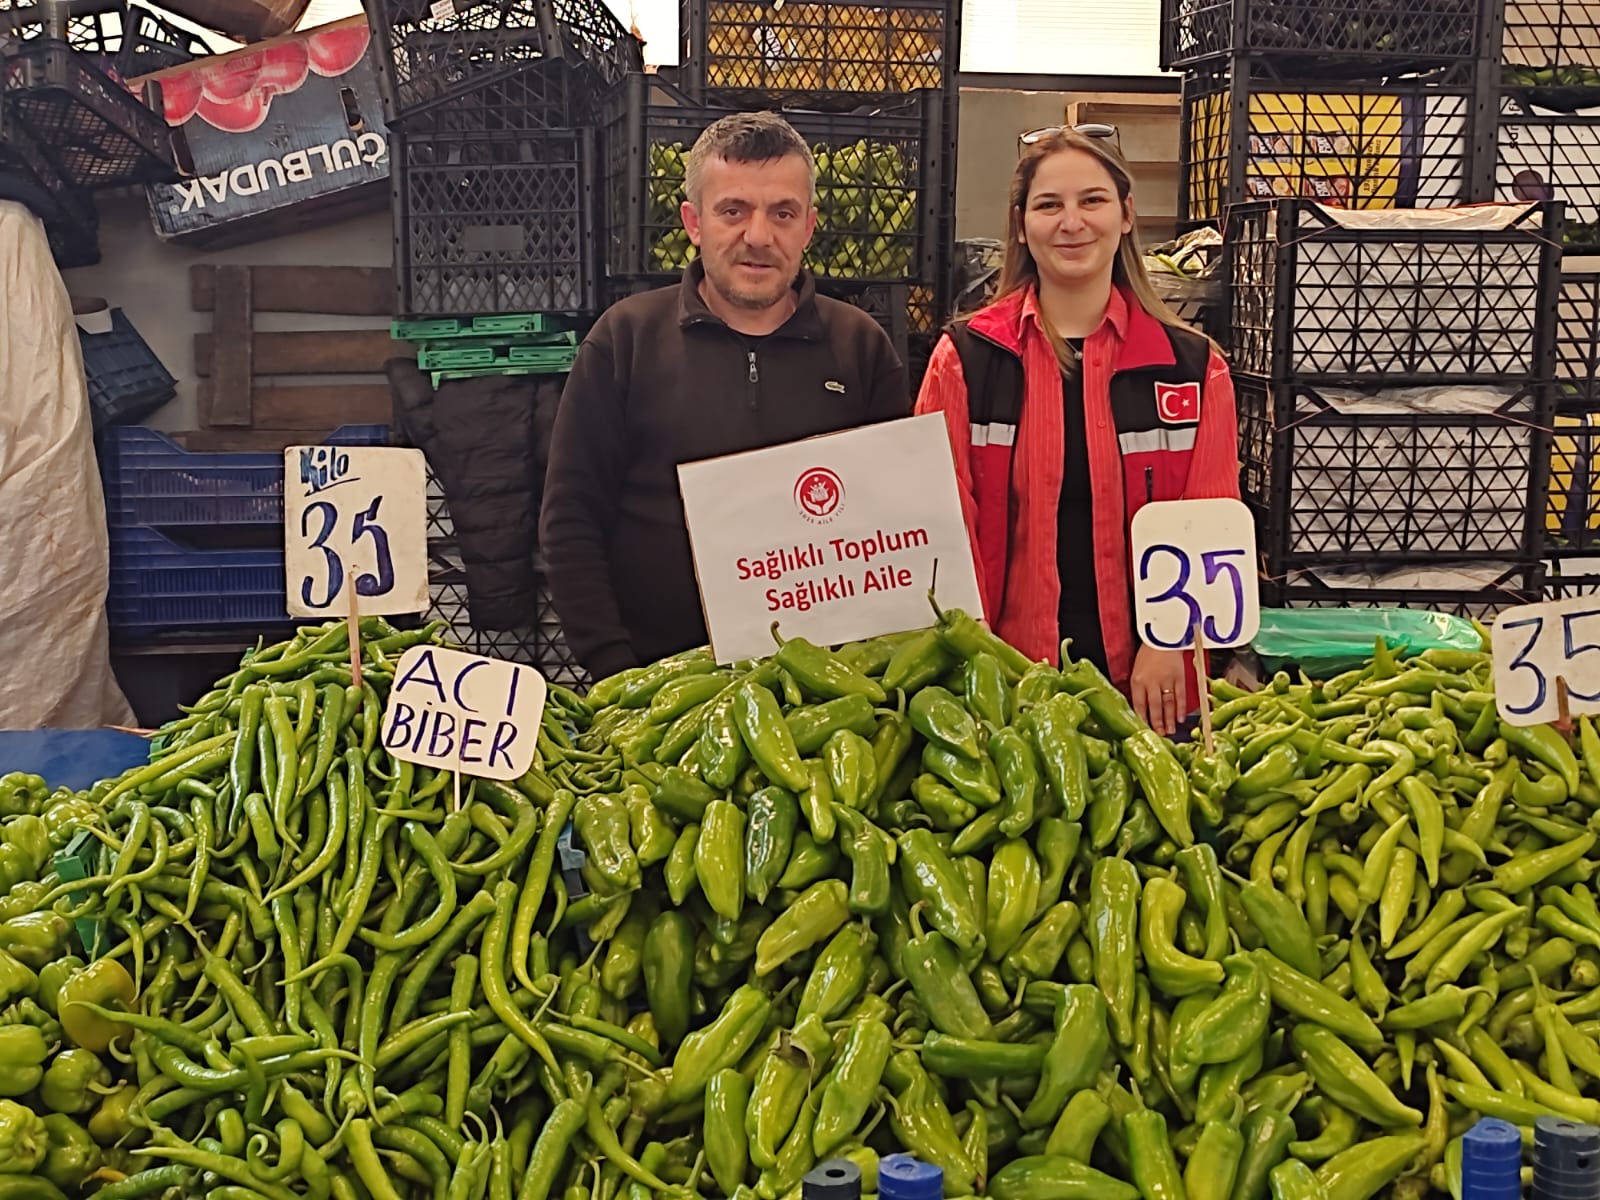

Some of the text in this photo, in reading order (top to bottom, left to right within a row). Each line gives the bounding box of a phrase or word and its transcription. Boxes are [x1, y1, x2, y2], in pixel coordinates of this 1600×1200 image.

[173, 132, 386, 213] GÜLBUDAK
[299, 446, 350, 488] Kilo
[301, 495, 395, 609] 35
[736, 527, 929, 580] Sağlıklı Toplum
[765, 564, 913, 612] Sağlıklı Aile
[1139, 544, 1246, 649] 35
[395, 650, 520, 717] ACI
[1502, 609, 1600, 715] 35
[384, 702, 519, 771] BİBER
